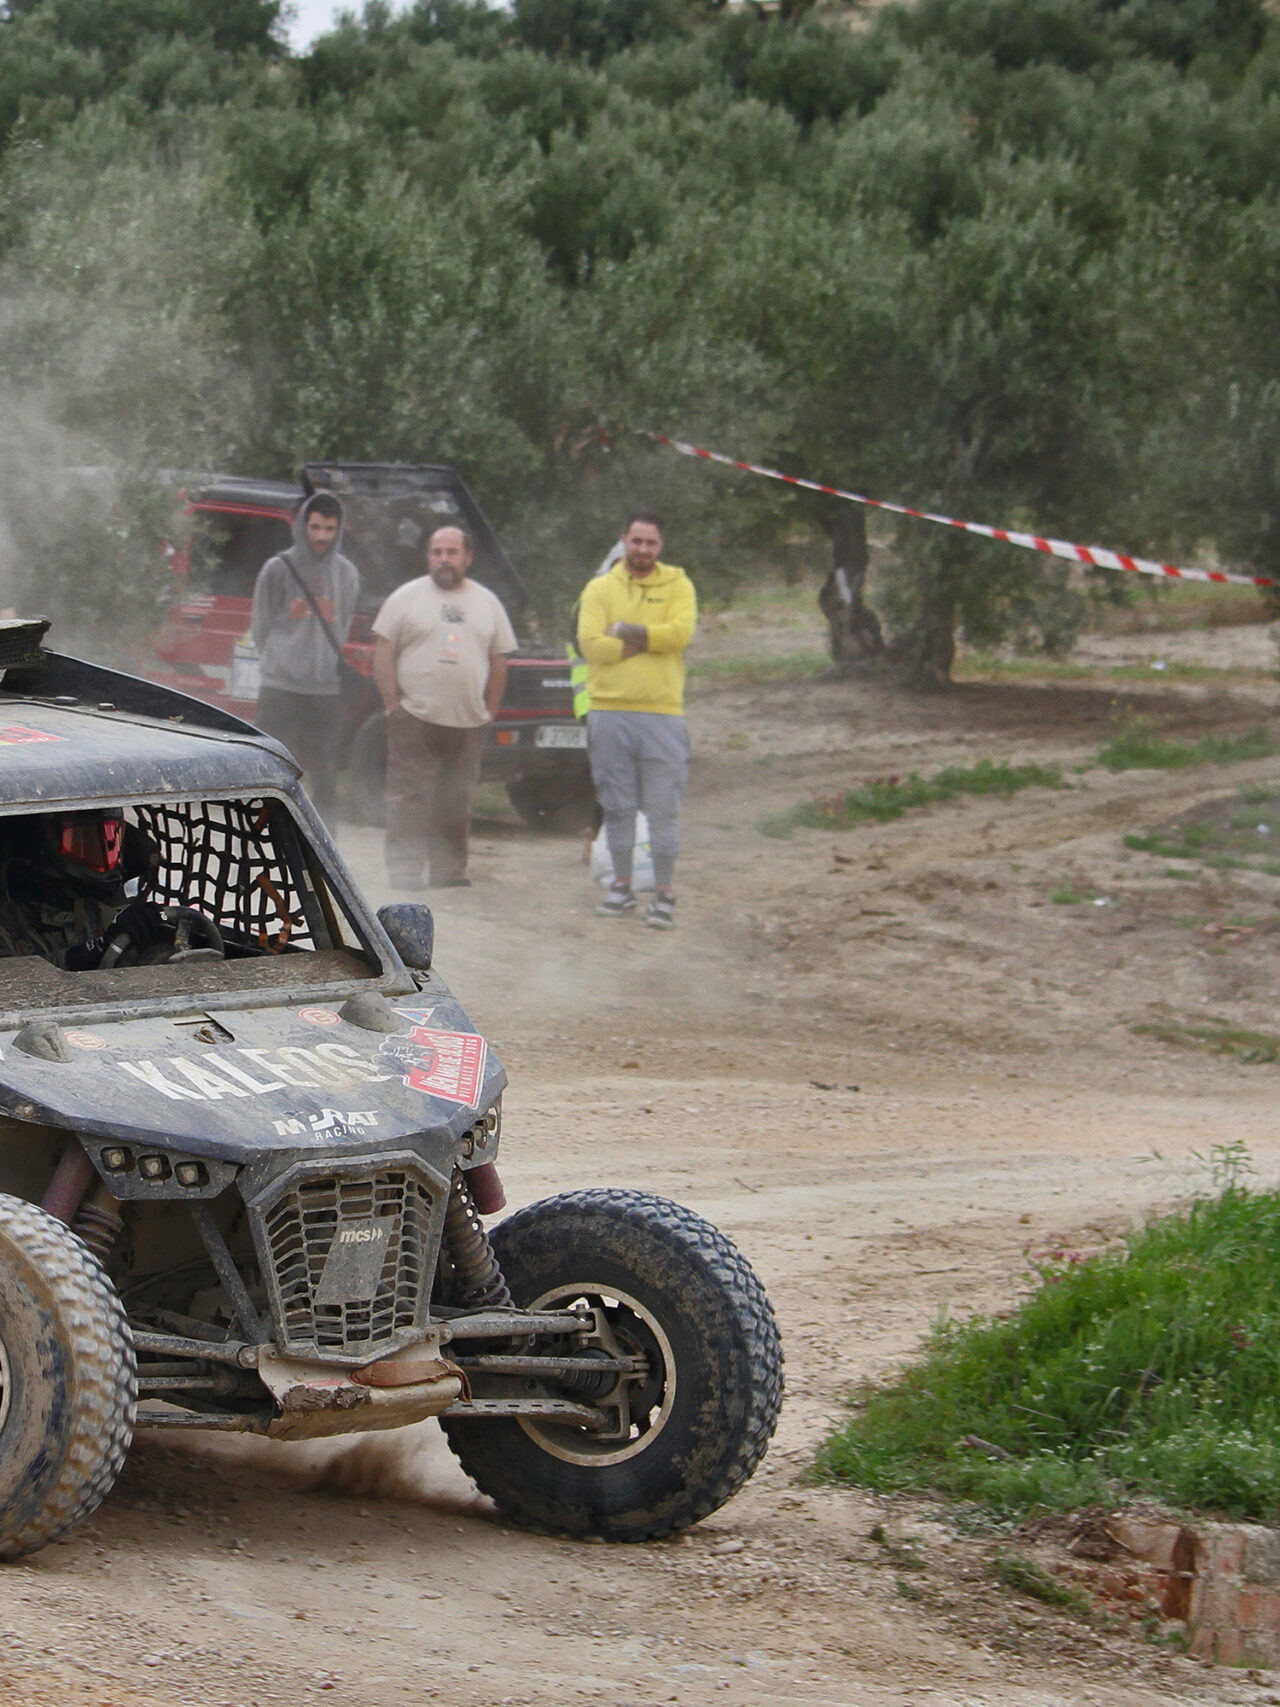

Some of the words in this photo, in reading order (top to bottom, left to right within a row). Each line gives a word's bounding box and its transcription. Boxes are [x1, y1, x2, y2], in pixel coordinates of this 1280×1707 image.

[117, 1043, 392, 1101] KALEOS
[314, 1125, 365, 1141] RACING
[340, 1229, 372, 1243] mcs
